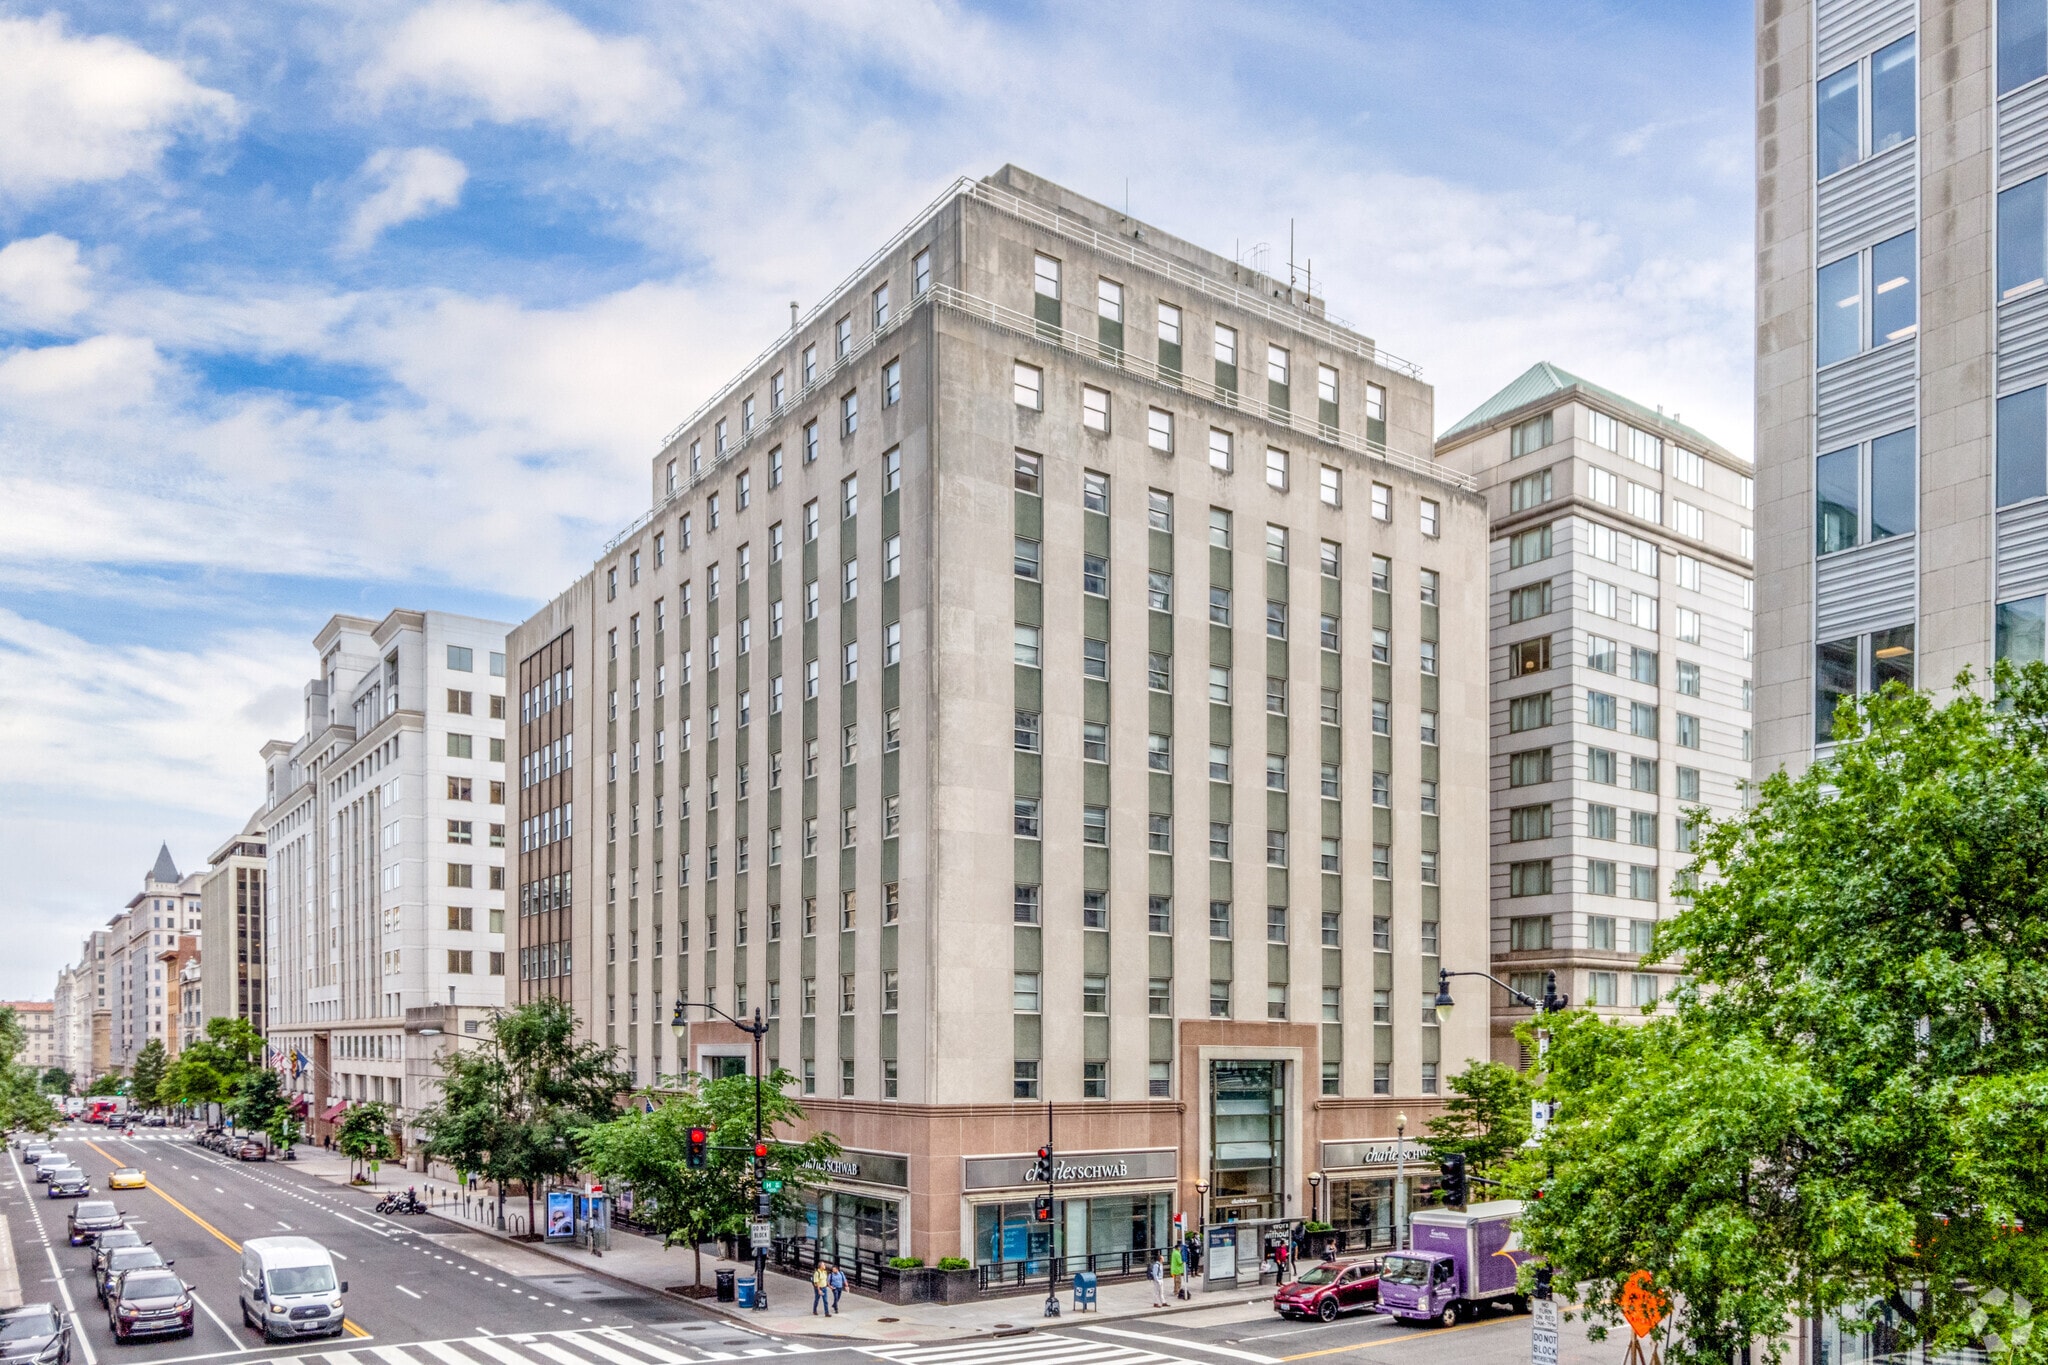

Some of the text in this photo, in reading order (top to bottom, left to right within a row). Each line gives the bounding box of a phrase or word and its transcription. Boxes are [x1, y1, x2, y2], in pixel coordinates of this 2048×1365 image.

[1365, 1146, 1400, 1163] charle
[827, 1160, 858, 1175] SCHWAB
[1025, 1160, 1128, 1181] chrles SCHWAB
[1534, 1333, 1557, 1344] DO NOT
[1533, 1344, 1557, 1356] BLOCK
